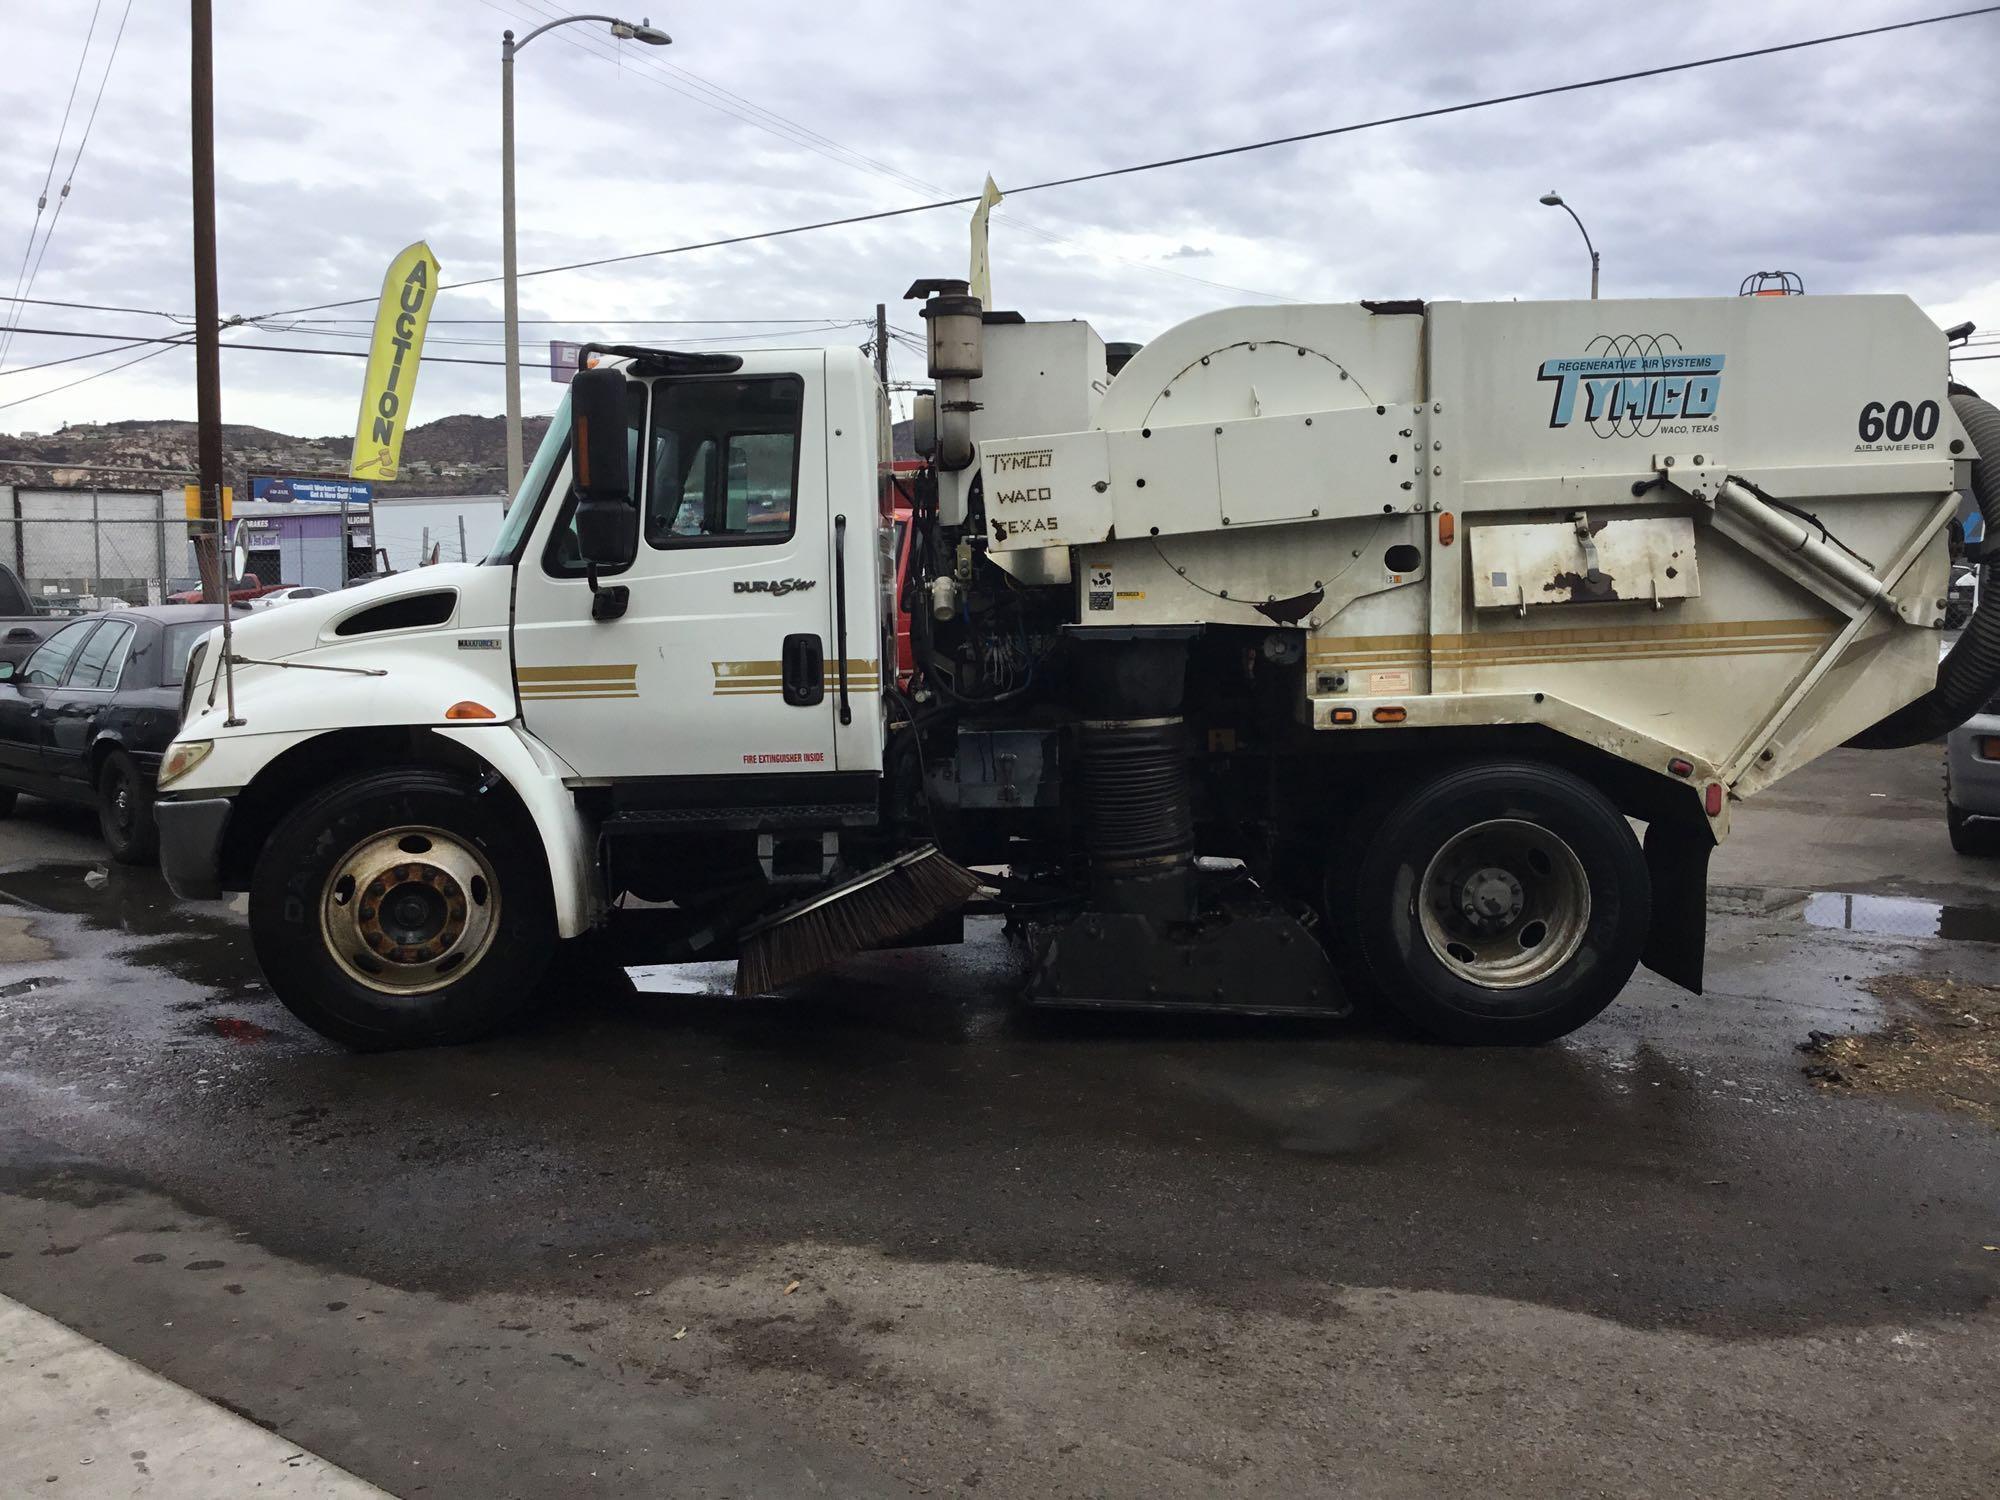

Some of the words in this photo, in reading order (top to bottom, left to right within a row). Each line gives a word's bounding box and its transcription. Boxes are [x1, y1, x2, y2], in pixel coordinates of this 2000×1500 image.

[372, 259, 428, 447] AUCTION
[1557, 359, 1637, 372] REGENERATIVE
[1641, 358, 1660, 370] AIR
[1663, 357, 1713, 370] SYSTEMS
[1536, 354, 1727, 429] TYMCO
[1660, 425, 1689, 435] WACO,
[1691, 424, 1720, 433] TEXAS
[1858, 399, 1940, 443] 600
[1854, 444, 1873, 452] AIR
[1875, 443, 1936, 452] SWEEPER
[985, 449, 1053, 474] TYMCO
[996, 487, 1052, 505] WACO
[743, 754, 758, 764] FIRE
[758, 753, 803, 764] EXTINGUISHER
[803, 752, 824, 762] INSIDE
